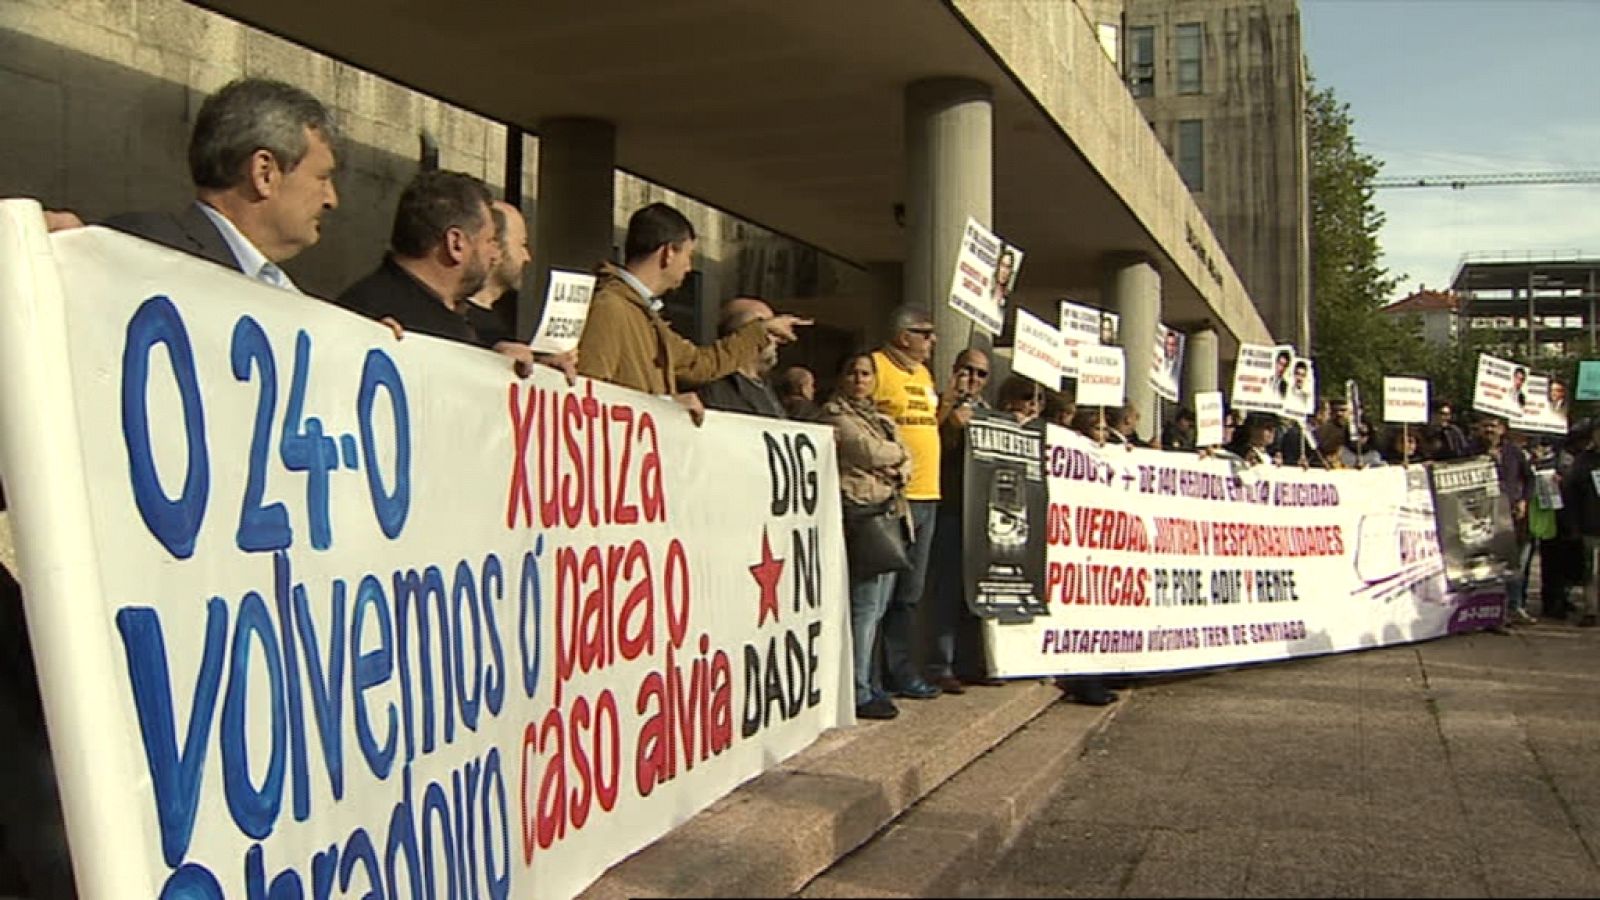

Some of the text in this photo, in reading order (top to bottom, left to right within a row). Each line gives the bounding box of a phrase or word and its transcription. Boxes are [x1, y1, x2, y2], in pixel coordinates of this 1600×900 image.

[121, 295, 210, 559] O
[763, 431, 818, 517] DIG
[793, 526, 821, 612] NI
[1212, 521, 1345, 558] RESPONSABILIDADES
[555, 538, 690, 707] para o
[1211, 569, 1242, 604] ADIF
[1244, 569, 1254, 603] Y
[1256, 569, 1299, 603] RENFE
[742, 622, 821, 738] DADE
[1042, 629, 1144, 654] PLATAFORMA
[1202, 627, 1231, 648] TREN
[1232, 624, 1248, 645] DE
[1250, 620, 1306, 643] SANTIAGO
[522, 634, 733, 866] caso alvia
